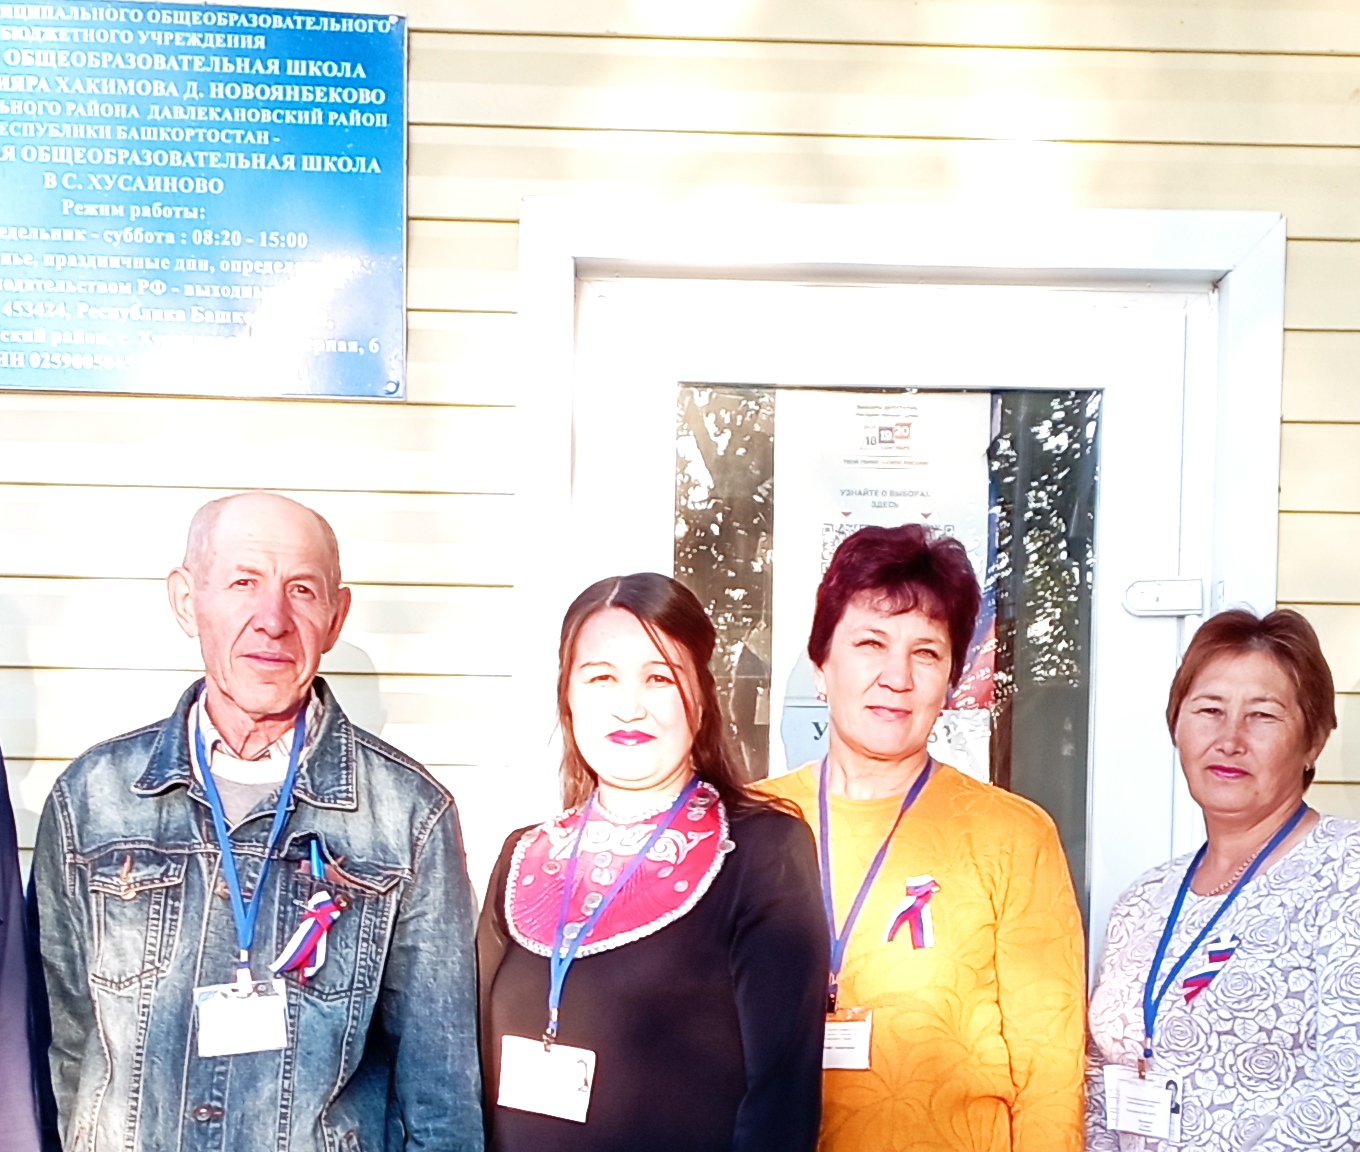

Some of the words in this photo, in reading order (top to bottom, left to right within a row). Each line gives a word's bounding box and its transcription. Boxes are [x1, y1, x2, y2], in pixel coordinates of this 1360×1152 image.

[147, 10, 390, 33] ОБЩЕОБРАЗОВАТЕЛЬНОГО
[0, 25, 134, 44] БЮДЖЕТНОГО
[138, 31, 266, 50] УЧРЕЖДЕНИЯ
[4, 48, 280, 75] ОБЩЕОБРАЗОВАТЕЛЬНАЯ
[286, 59, 366, 78] ШКОЛА
[55, 76, 179, 97] ХАКИМОВА
[184, 83, 204, 100] Д.
[210, 82, 386, 105] НОВОЯНБЕКОВО
[66, 101, 139, 118] РАЙОНА
[147, 104, 323, 125] ДАВЛЕКАНОВСКИЙ
[329, 107, 388, 127] РАЙОН
[116, 125, 269, 145] БАШКОРТОСТАН
[21, 145, 295, 171] ОБЩЕОБРАЗОВАТЕЛЬНАЯ
[301, 155, 382, 173] ШКОЛА
[43, 172, 57, 189] В
[61, 173, 82, 190] С.
[62, 199, 124, 217] Режим
[130, 202, 205, 221] работы:
[102, 226, 175, 247] суббота
[192, 229, 242, 247] 08:20
[260, 231, 308, 249] 15:00
[43, 253, 170, 270] праздничные
[174, 258, 215, 274] дни,
[138, 279, 167, 296] РФ
[76, 302, 186, 323] Республика
[369, 338, 380, 353] 6
[893, 425, 910, 437] 20
